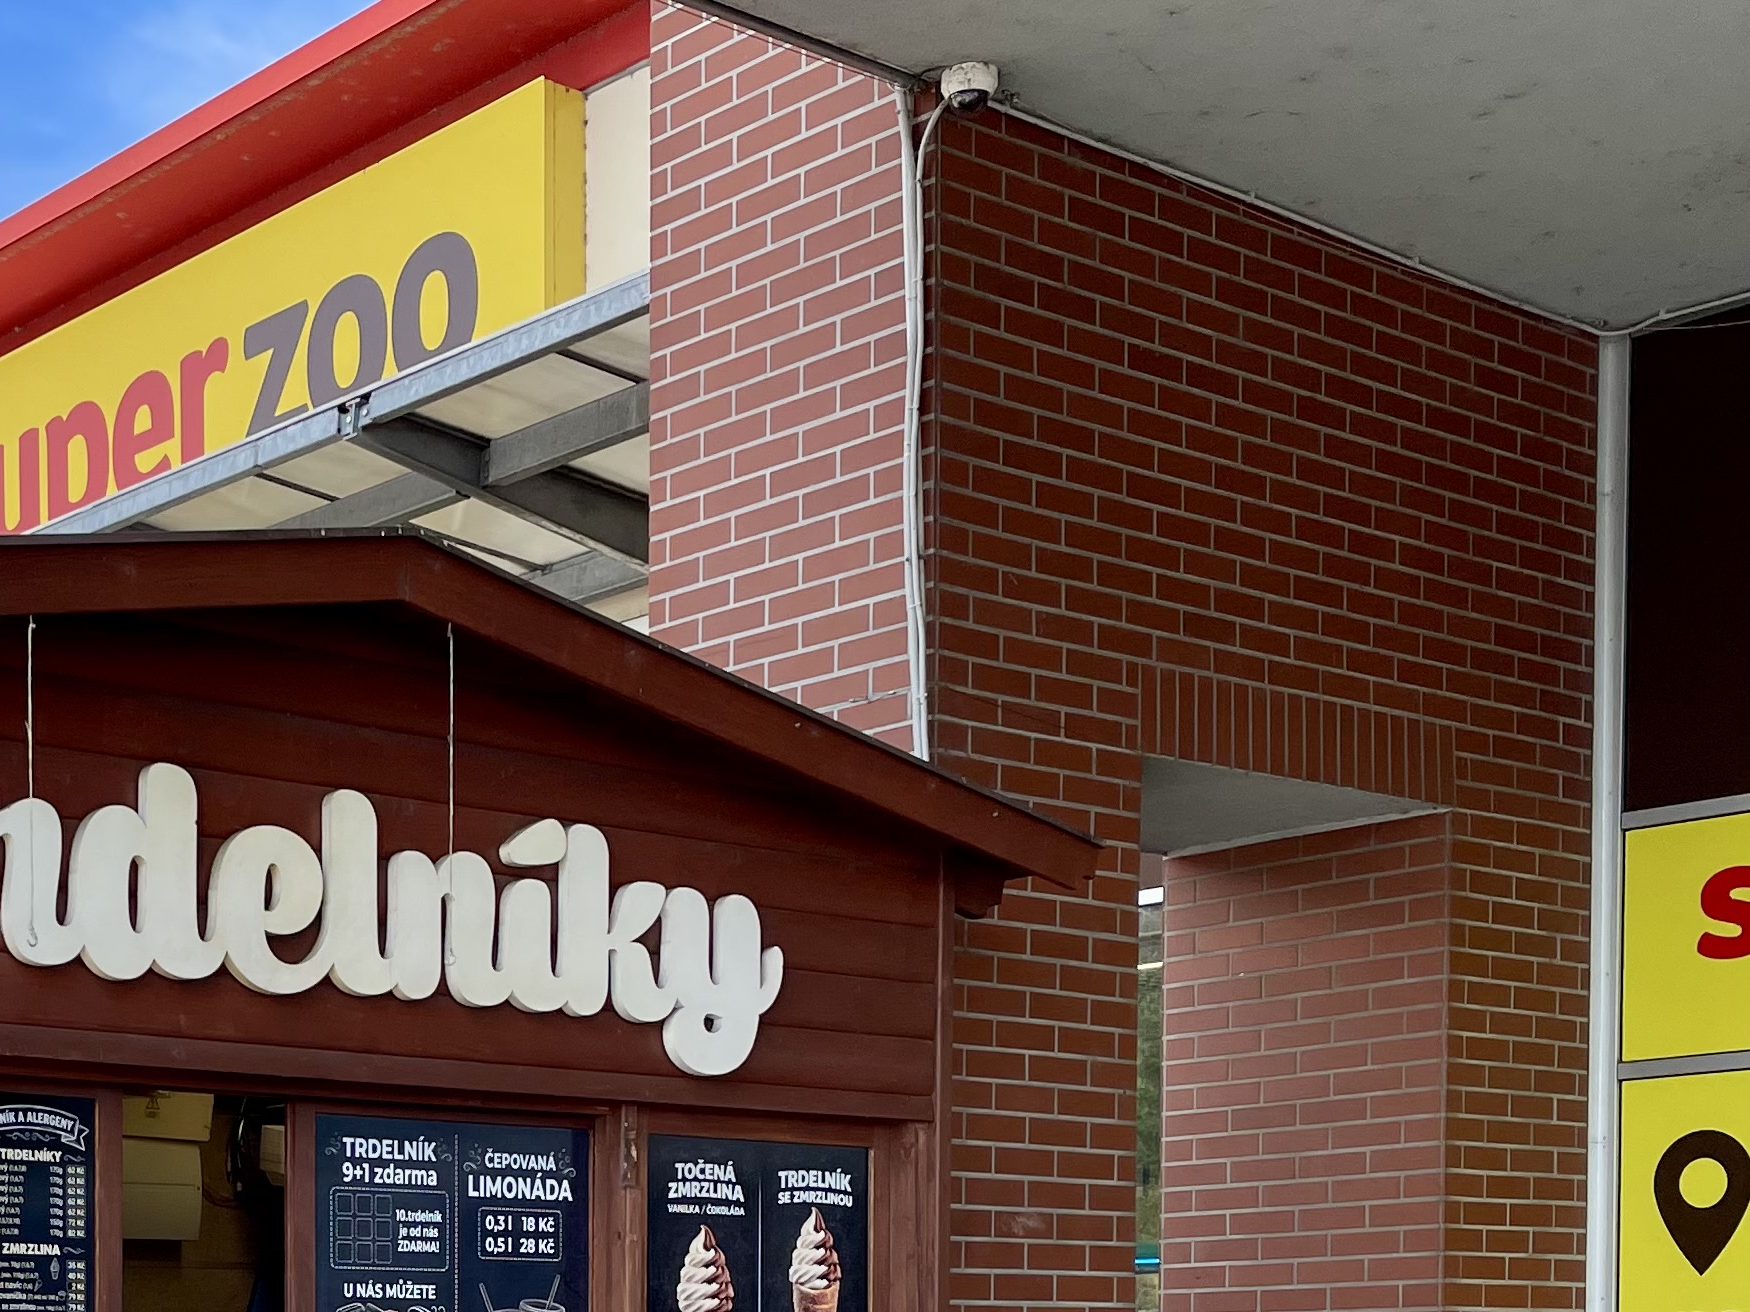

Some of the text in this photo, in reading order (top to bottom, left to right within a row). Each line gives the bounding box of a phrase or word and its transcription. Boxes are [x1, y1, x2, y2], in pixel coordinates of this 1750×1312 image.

[18, 1111, 25, 1122] A
[27, 1112, 74, 1131] ALERGENY
[0, 1147, 62, 1162] TRDELNÍKY
[343, 1136, 436, 1161] TRDELNÍK
[484, 1148, 556, 1172] ČEPOVANÁ
[342, 1162, 437, 1185] 9+1 zdarma
[675, 1159, 736, 1183] TOČENÁ
[778, 1168, 851, 1193] TRDELNÍK
[467, 1174, 573, 1202] LIMONÁDA
[668, 1182, 744, 1202] ZMRZLINA
[778, 1189, 852, 1207] SE ZMRZLINOU
[396, 1209, 442, 1222] 10.trdelník
[667, 1204, 745, 1215] VANILKA ČOKOLÁDA
[398, 1224, 438, 1239] je od nás
[486, 1215, 505, 1232] 0,3
[522, 1217, 535, 1231] 18
[539, 1217, 555, 1232] Kč
[2, 1243, 61, 1255] ZMRZLINA
[398, 1240, 439, 1252] ZDARMA!
[486, 1237, 505, 1254] 0,5
[520, 1238, 535, 1253] 28
[539, 1238, 554, 1253] Kč
[344, 1279, 436, 1299] U NÁS MŮŽETE
